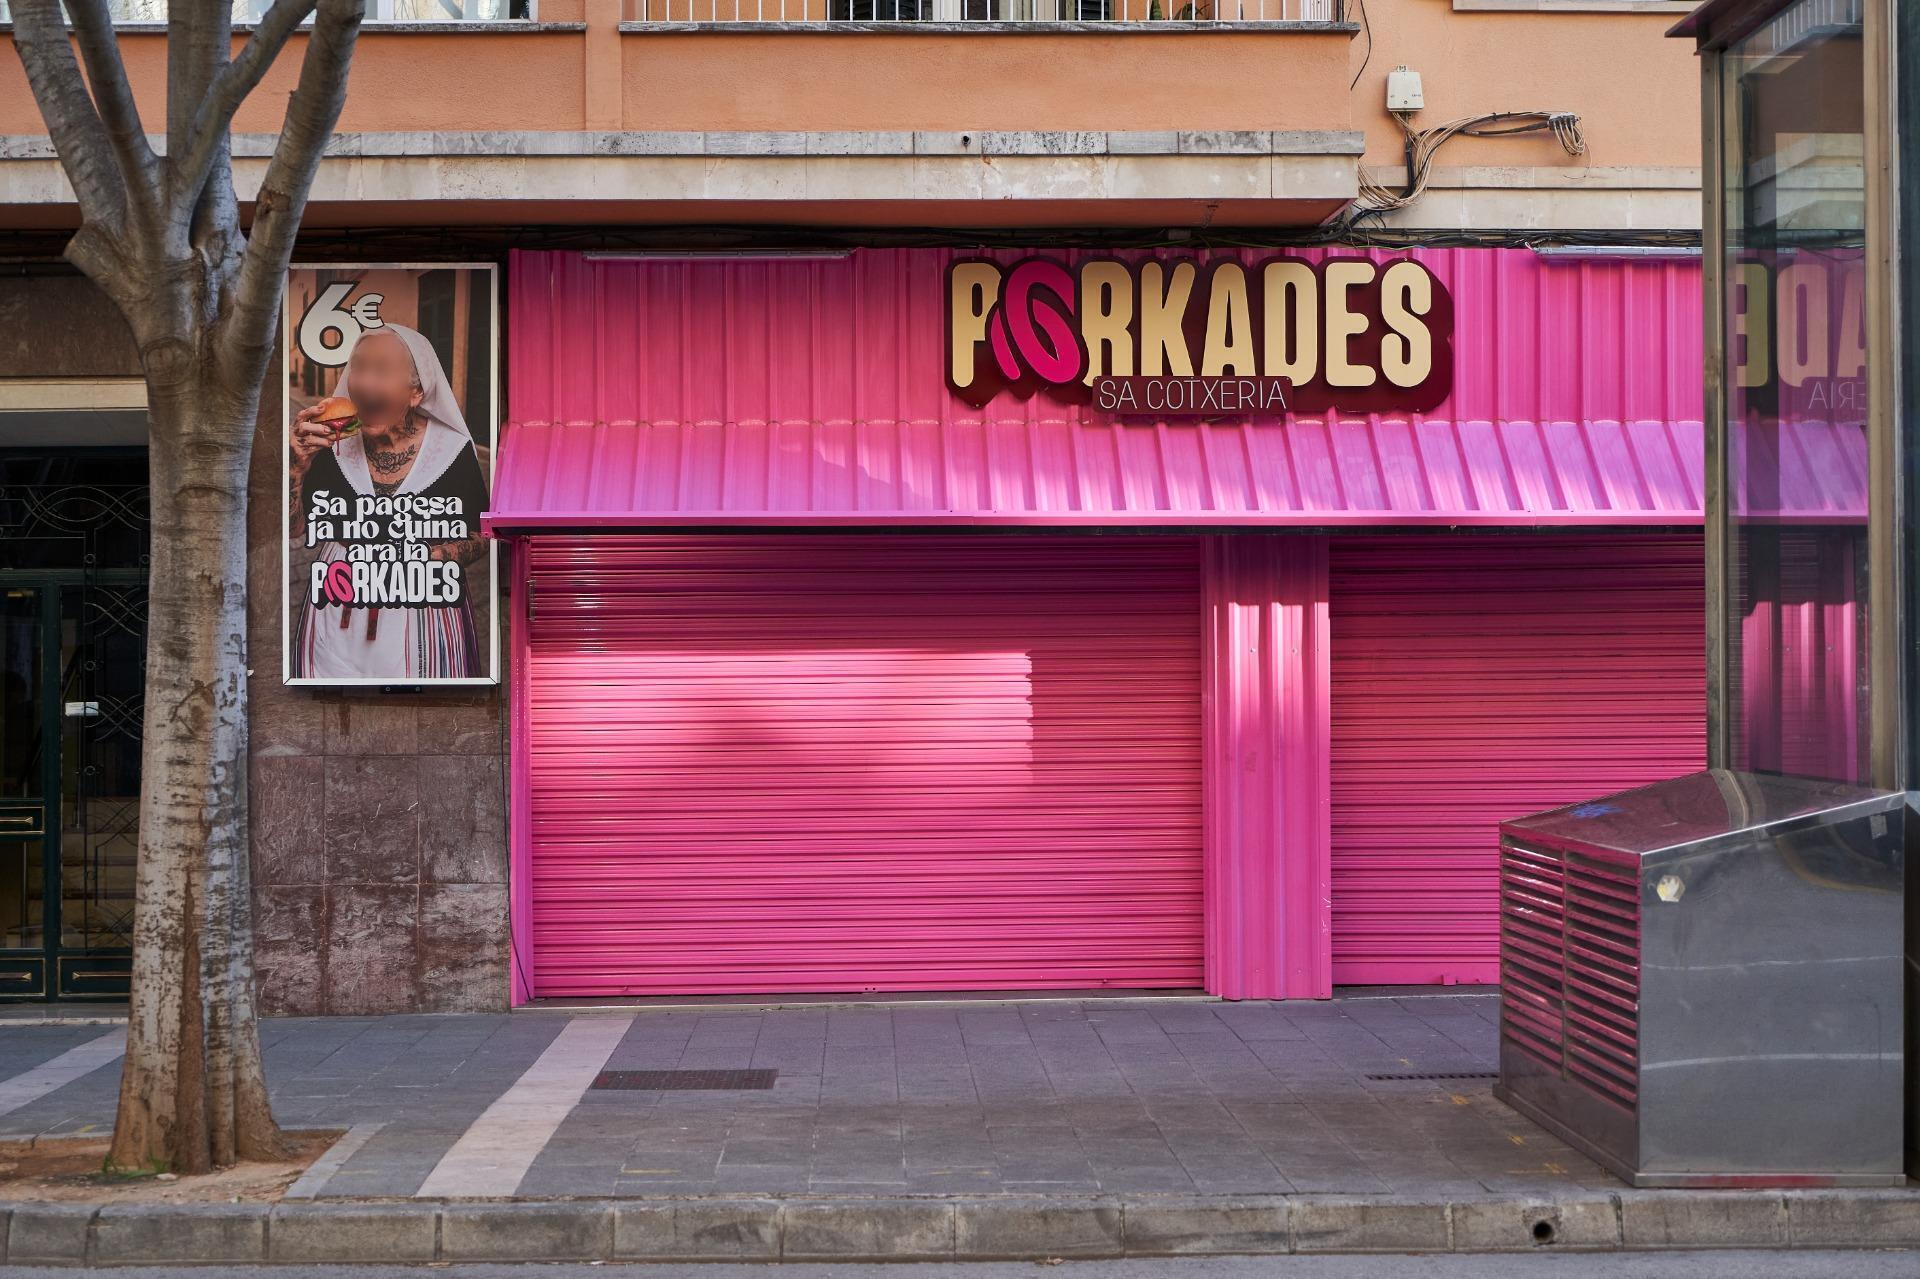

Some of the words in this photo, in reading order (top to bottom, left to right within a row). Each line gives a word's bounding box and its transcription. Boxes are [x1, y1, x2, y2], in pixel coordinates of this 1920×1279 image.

[951, 260, 1432, 388] PORKADES
[1099, 380, 1138, 409] SA
[1147, 379, 1287, 410] COTXERIA
[311, 489, 347, 516] Sa
[355, 494, 463, 526] pagesa
[306, 512, 334, 547] ja
[342, 519, 380, 539] no
[387, 517, 468, 540] cuina
[347, 542, 397, 562] ara
[403, 538, 429, 562] la
[311, 560, 460, 604] PORKADES
